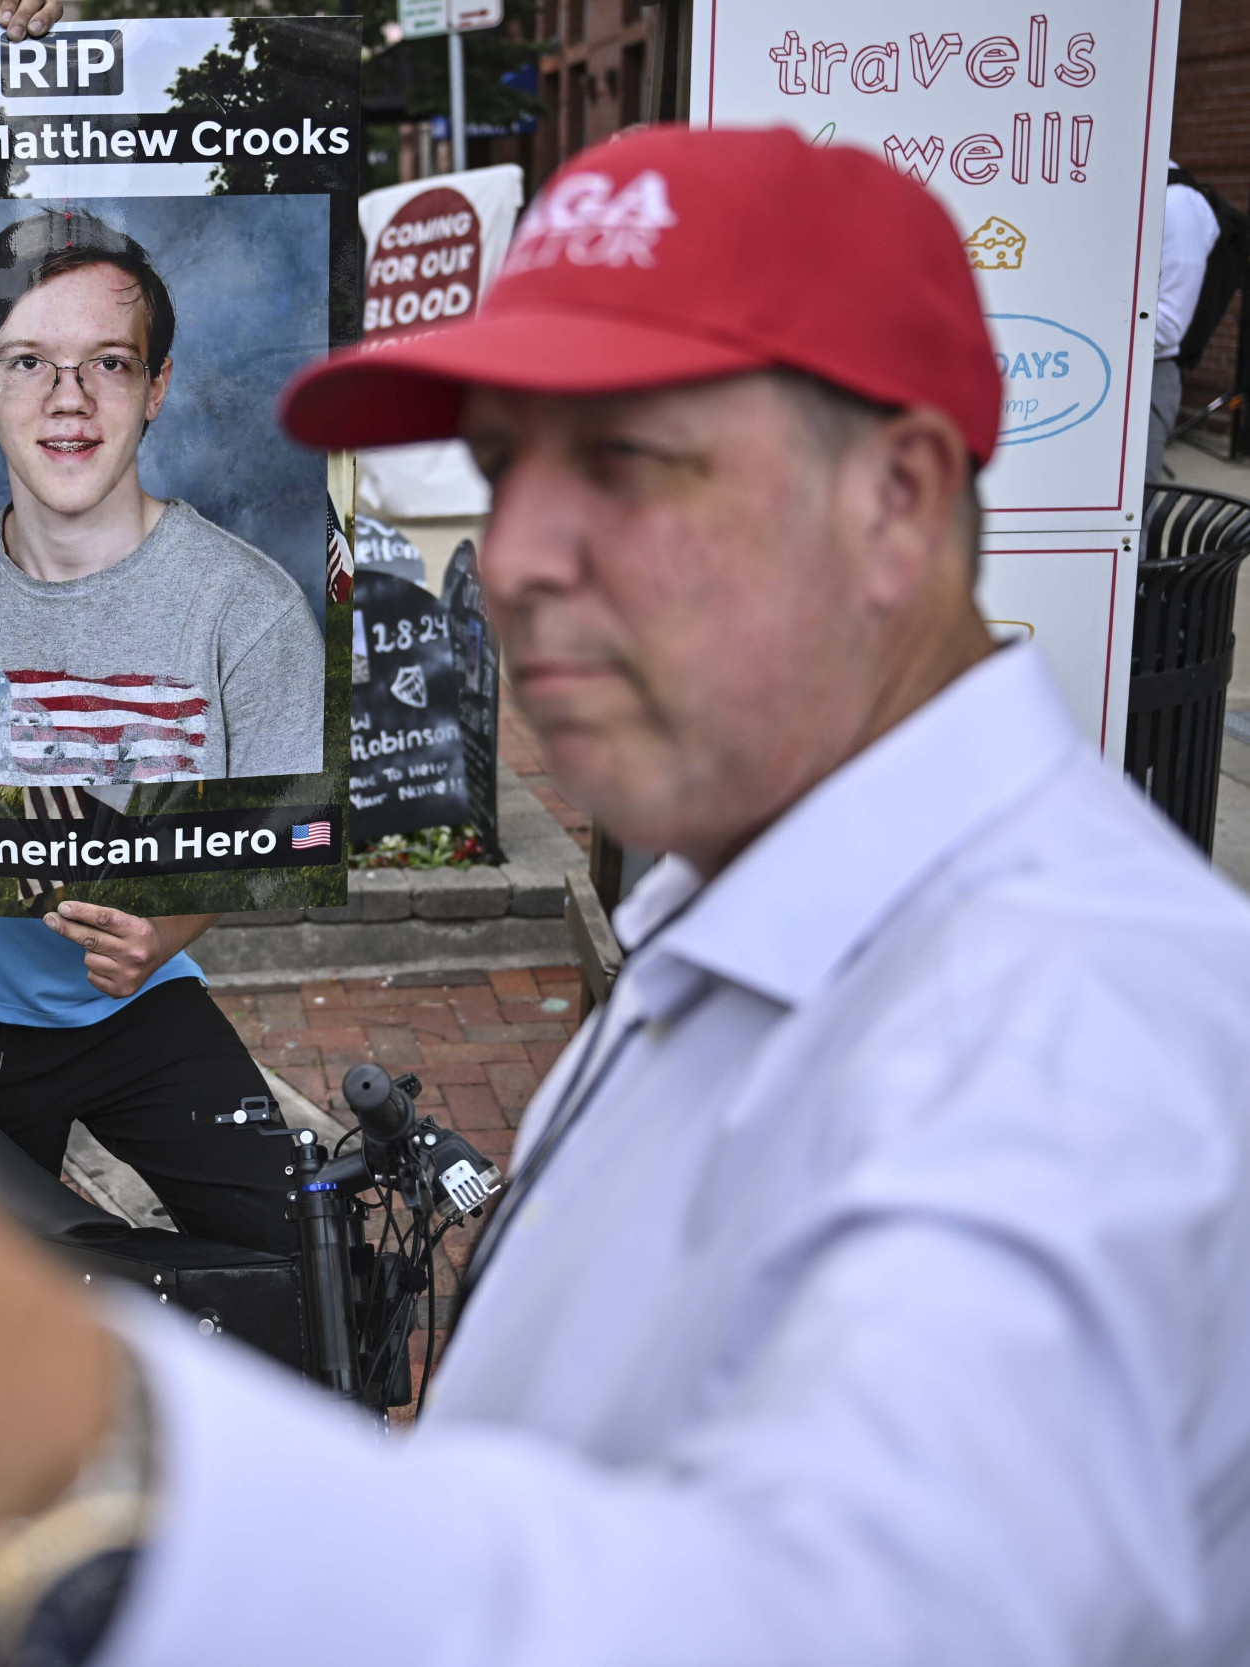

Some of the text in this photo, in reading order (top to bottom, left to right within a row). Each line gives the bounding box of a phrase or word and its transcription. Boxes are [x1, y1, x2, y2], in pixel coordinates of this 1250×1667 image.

[9, 38, 114, 89] RIP
[769, 14, 1096, 95] travels
[191, 119, 349, 156] Crooks
[883, 111, 1093, 187] well!
[380, 211, 473, 249] COMING
[369, 254, 418, 288] FOR
[363, 282, 472, 331] BLOOD
[995, 351, 1070, 379] DAYS
[350, 723, 460, 761] Robinson
[174, 826, 277, 860] Hero
